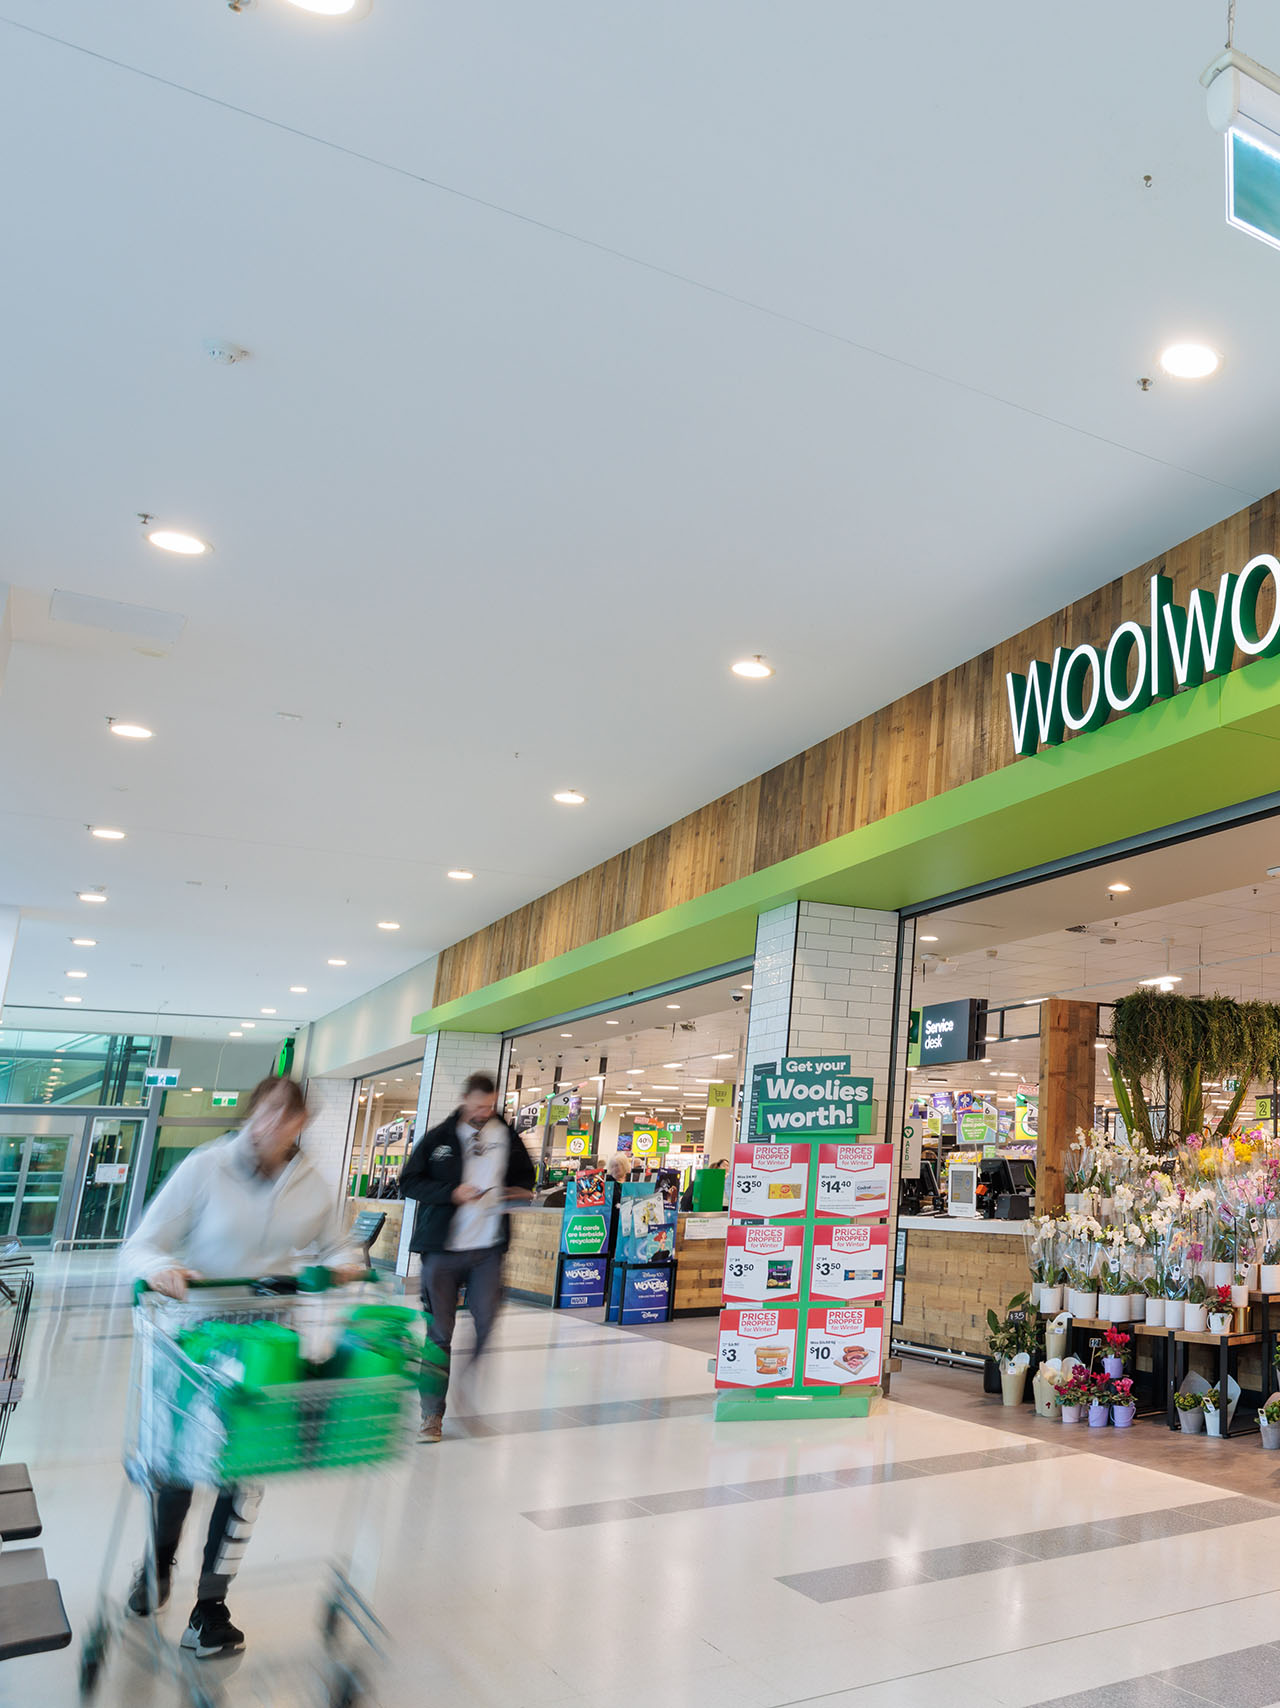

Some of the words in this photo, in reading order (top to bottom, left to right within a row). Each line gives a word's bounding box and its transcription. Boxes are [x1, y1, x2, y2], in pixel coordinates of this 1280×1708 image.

[925, 1018, 954, 1035] Service
[924, 1034, 943, 1050] desk
[786, 1060, 813, 1073] Get
[815, 1061, 846, 1075] your
[766, 1078, 869, 1101] Woolies
[562, 1096, 570, 1104] 9
[527, 1107, 538, 1115] 10
[1029, 1108, 1034, 1116] 7
[1259, 1100, 1268, 1116] 2
[767, 1104, 853, 1129] worth!
[834, 1228, 868, 1236] PRICES
[569, 1237, 601, 1245] recyclable
[564, 1268, 599, 1279] WONDERS
[634, 1278, 668, 1291] WONDERS
[641, 1311, 659, 1319] Disney
[741, 1312, 776, 1320] PRICES
[829, 1311, 863, 1319] PRICES
[722, 1349, 737, 1362] $3
[809, 1346, 830, 1359] $10
